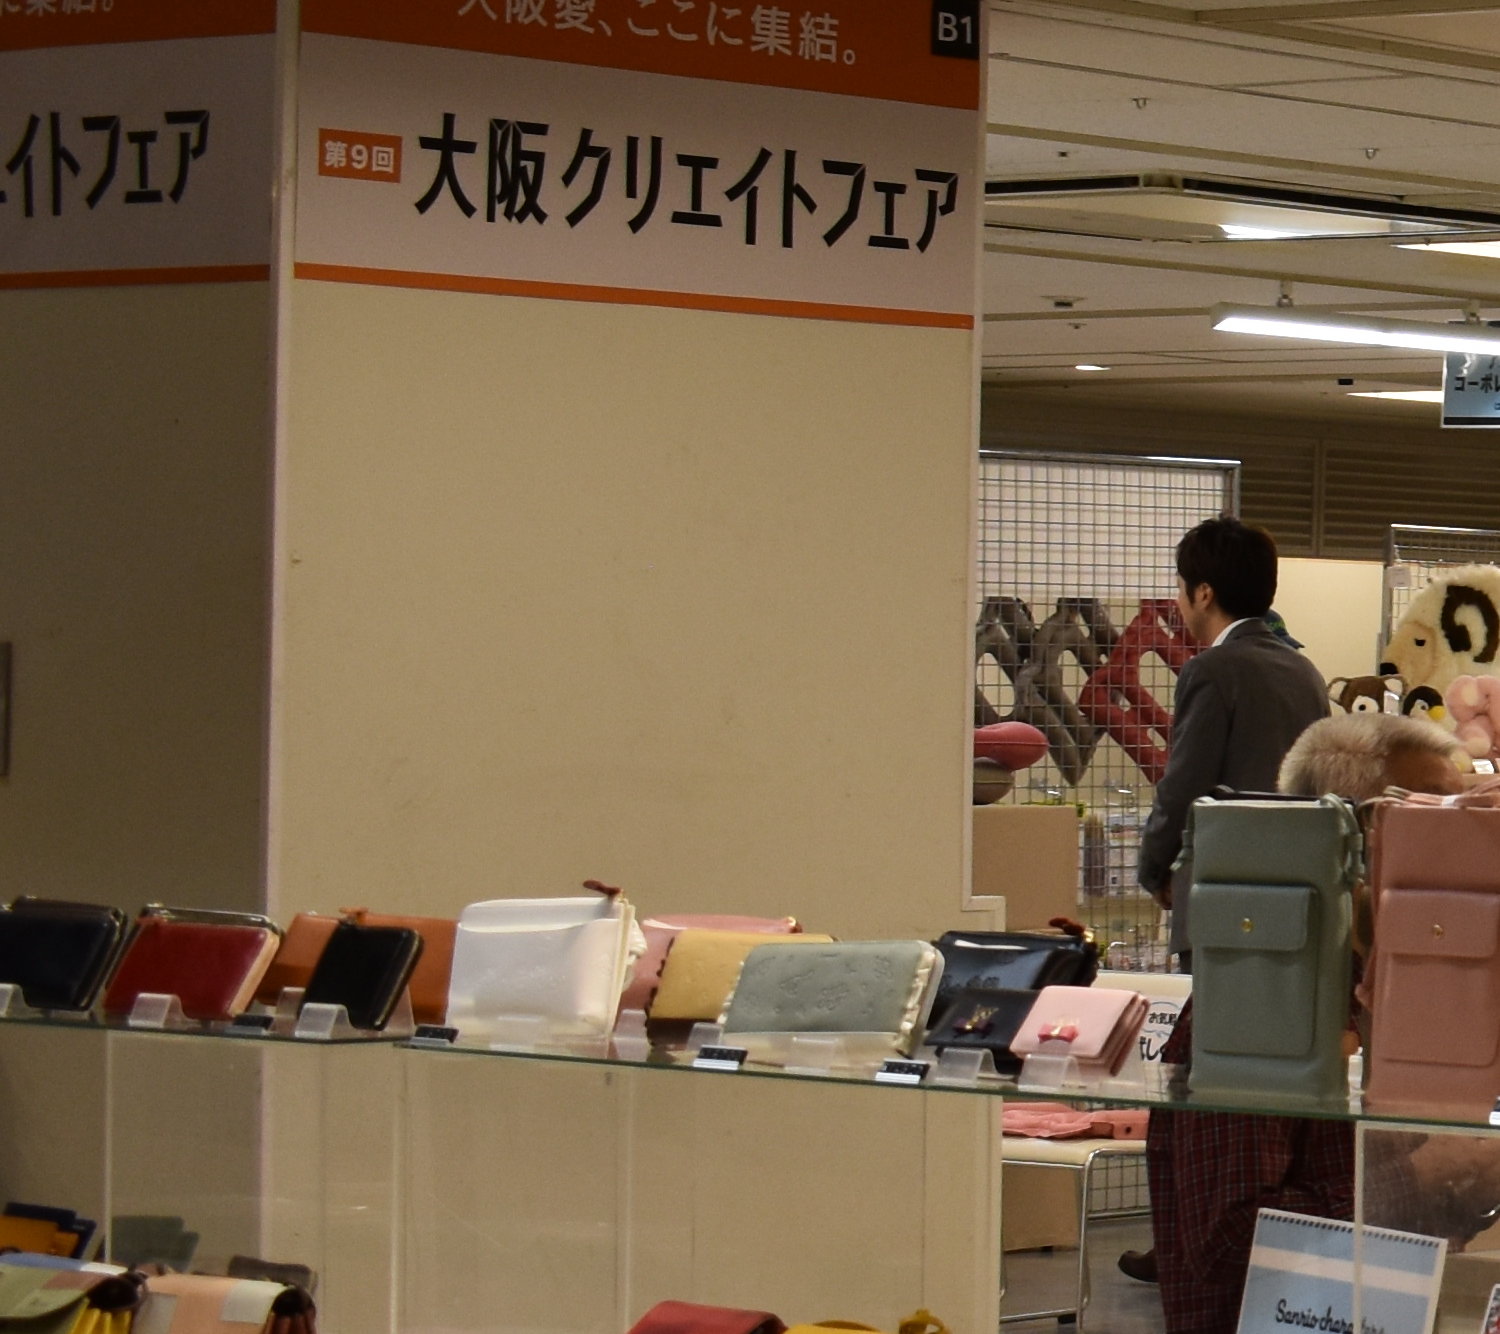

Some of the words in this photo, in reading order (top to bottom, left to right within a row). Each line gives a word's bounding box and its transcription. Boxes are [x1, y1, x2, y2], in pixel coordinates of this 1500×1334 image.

[937, 11, 975, 46] B1
[0, 109, 210, 218] イトフェア
[323, 139, 395, 173] 第9回
[414, 112, 959, 254] 大阪クリエイトフェア
[1275, 1298, 1319, 1329] Sanrio
